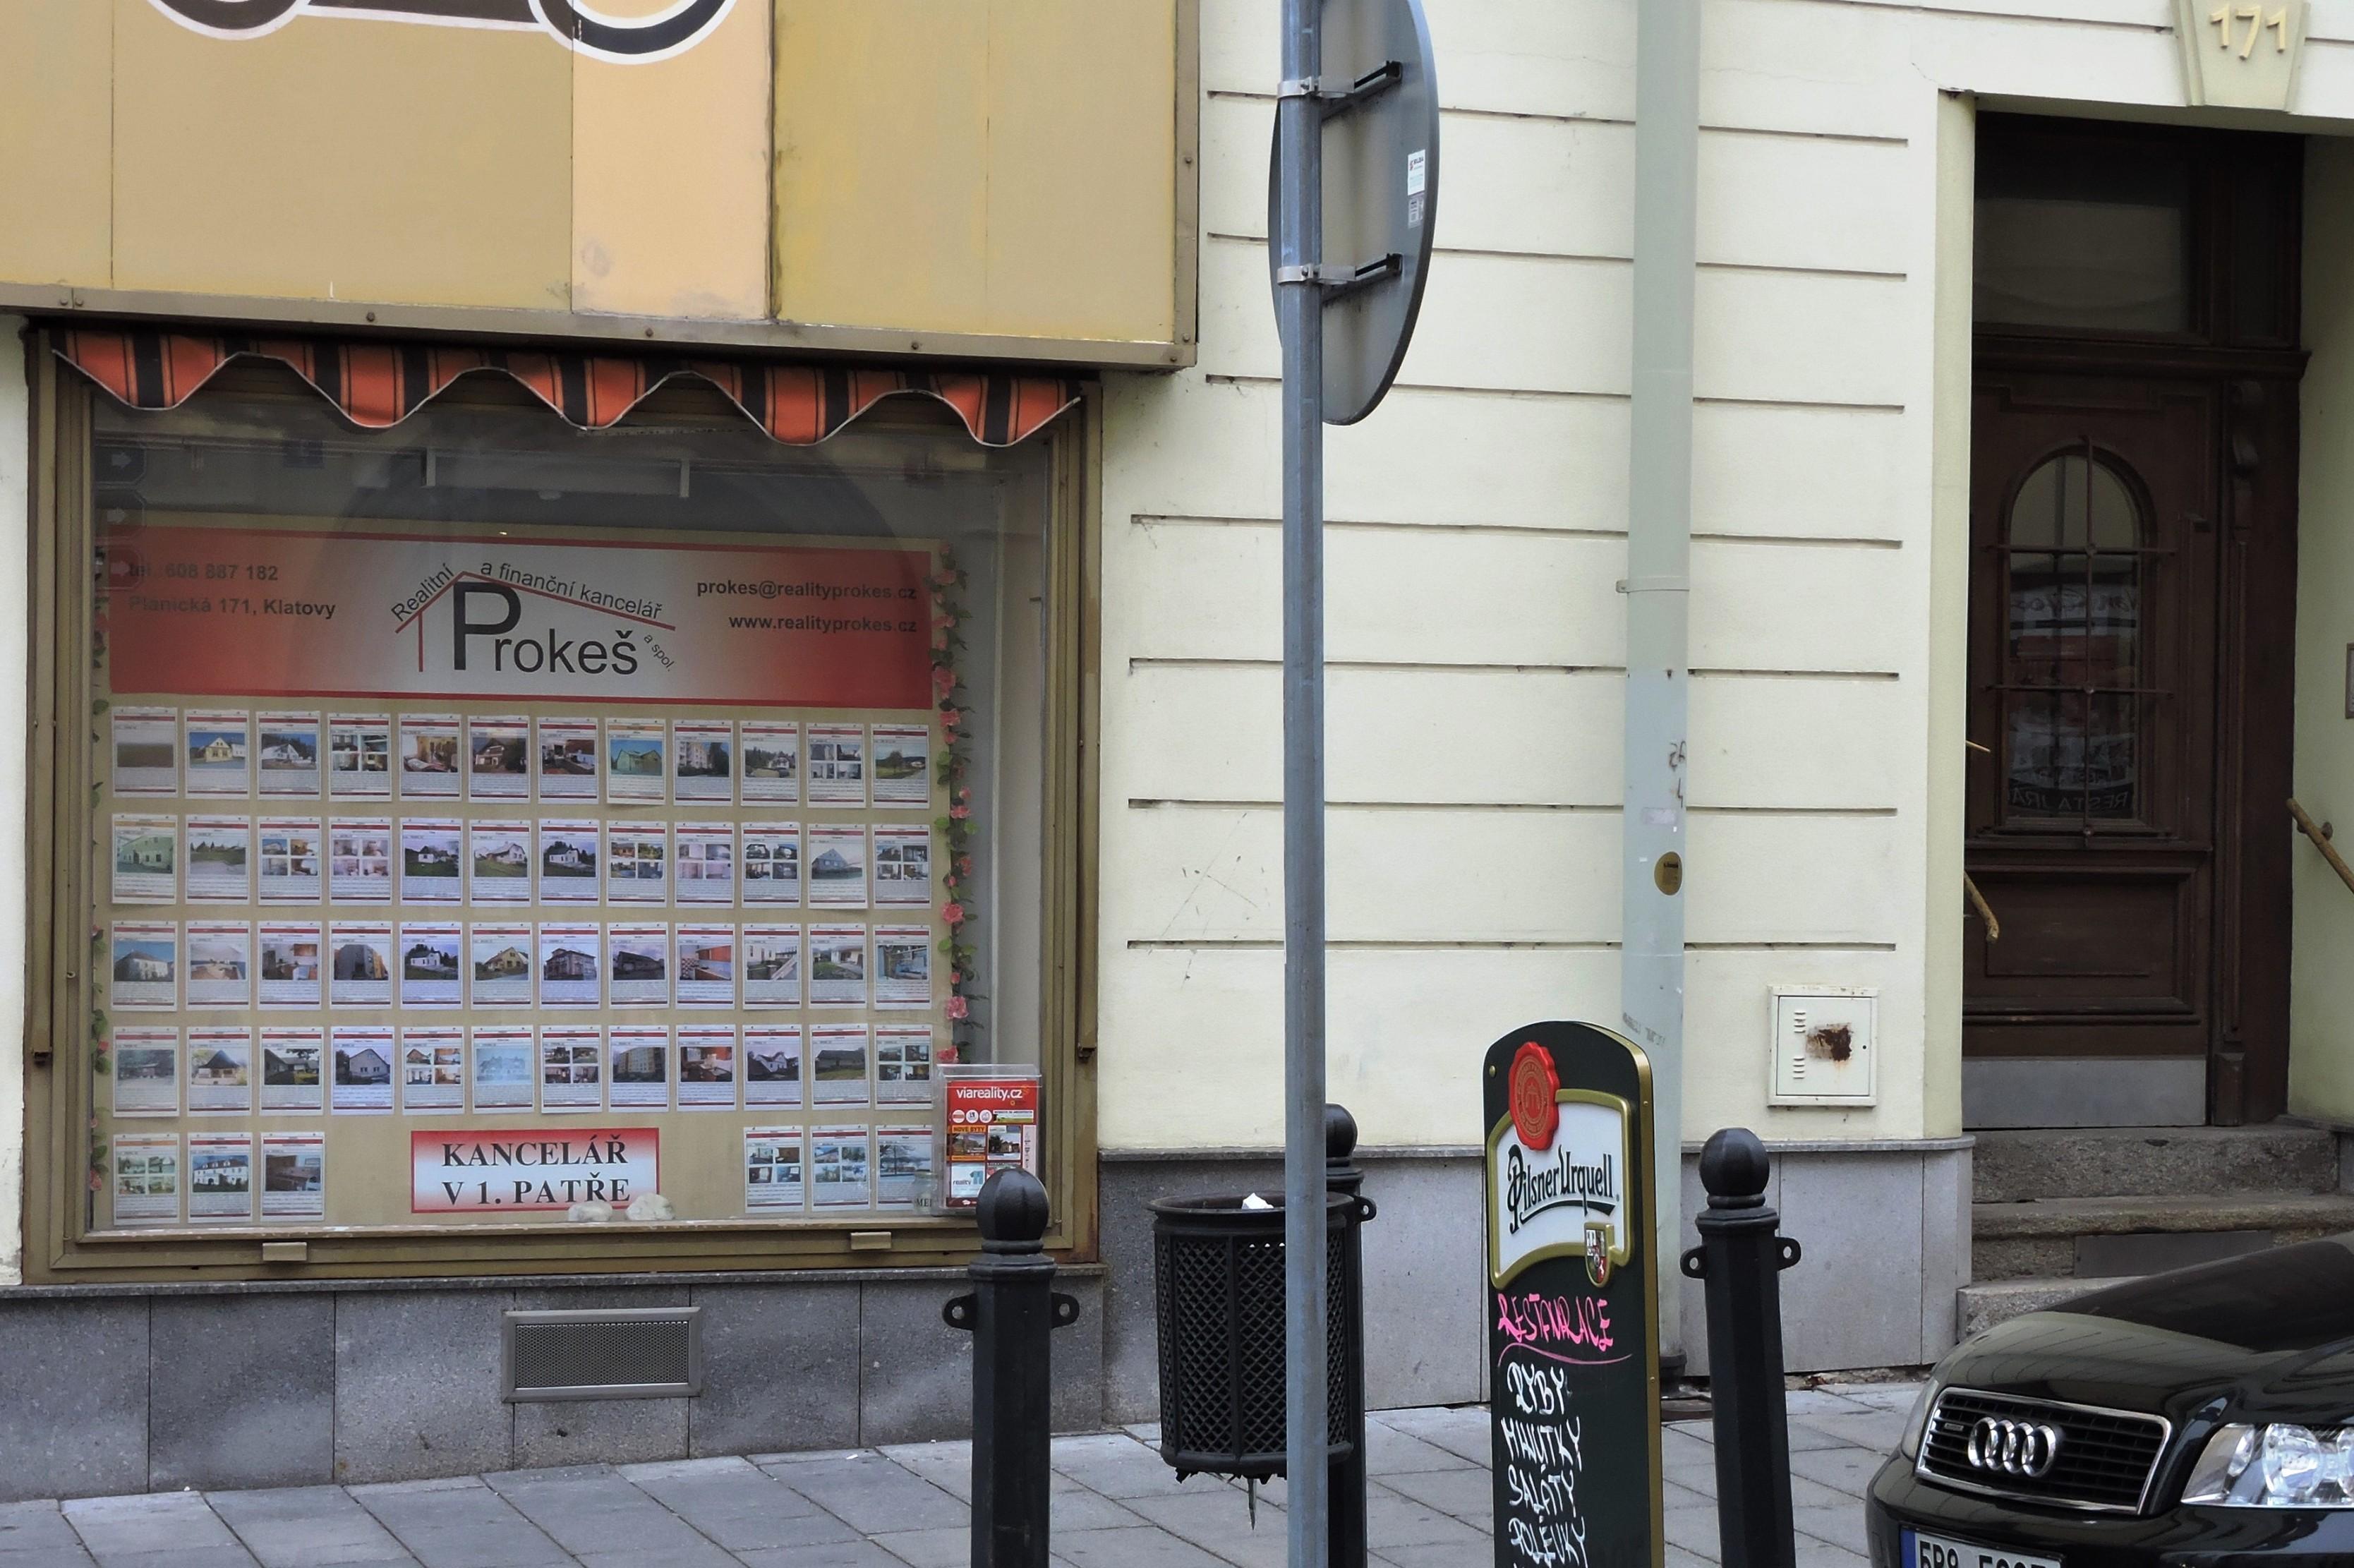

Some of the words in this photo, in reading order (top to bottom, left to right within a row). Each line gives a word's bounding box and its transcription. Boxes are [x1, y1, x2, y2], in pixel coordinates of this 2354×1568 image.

[2209, 3, 2287, 61] 171
[247, 566, 278, 581] 182
[390, 562, 455, 622] Realitní
[480, 562, 493, 576] a
[499, 563, 577, 597] finanční
[579, 584, 663, 620] kancelář
[219, 598, 257, 616] 171,
[263, 599, 336, 620] Klatovy
[453, 581, 639, 675] Prokeš
[728, 615, 917, 634] www.realityprokes.cz
[644, 634, 653, 644] a
[651, 643, 676, 672] spol.
[956, 1086, 1023, 1102] viareality.cz
[442, 1133, 629, 1167] KANCELÁŘ
[441, 1181, 464, 1205] V
[477, 1181, 502, 1205] 1.
[512, 1171, 631, 1204] PATŘE
[1507, 1144, 1559, 1235] Pilsner
[1557, 1144, 1614, 1217] Urquell
[1497, 1292, 1614, 1352] RESTAURACE
[1507, 1361, 1564, 1416] RYBY
